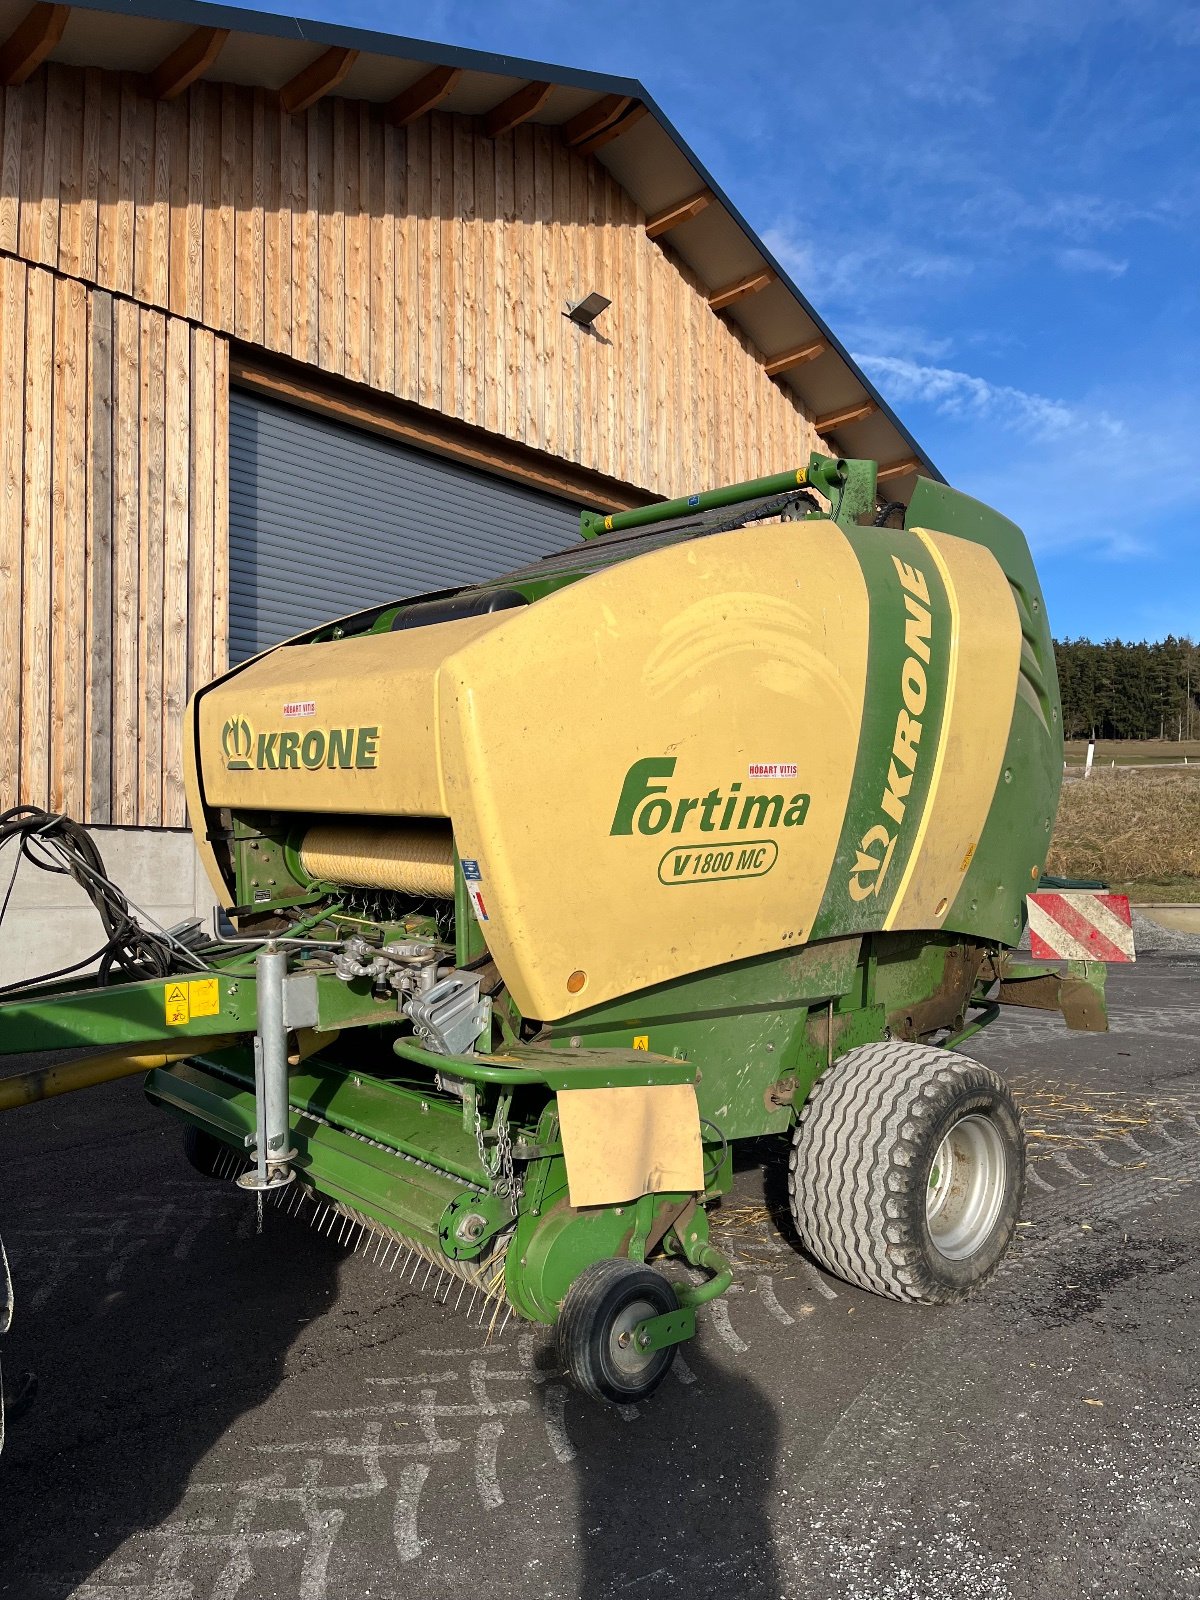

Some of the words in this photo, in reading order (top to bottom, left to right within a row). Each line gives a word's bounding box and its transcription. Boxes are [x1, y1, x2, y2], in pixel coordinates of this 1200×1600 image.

[880, 554, 932, 825] KRONE
[256, 727, 379, 770] KRONE
[780, 765, 797, 774] VITIS
[609, 757, 811, 836] Fortima
[736, 848, 766, 871] MC
